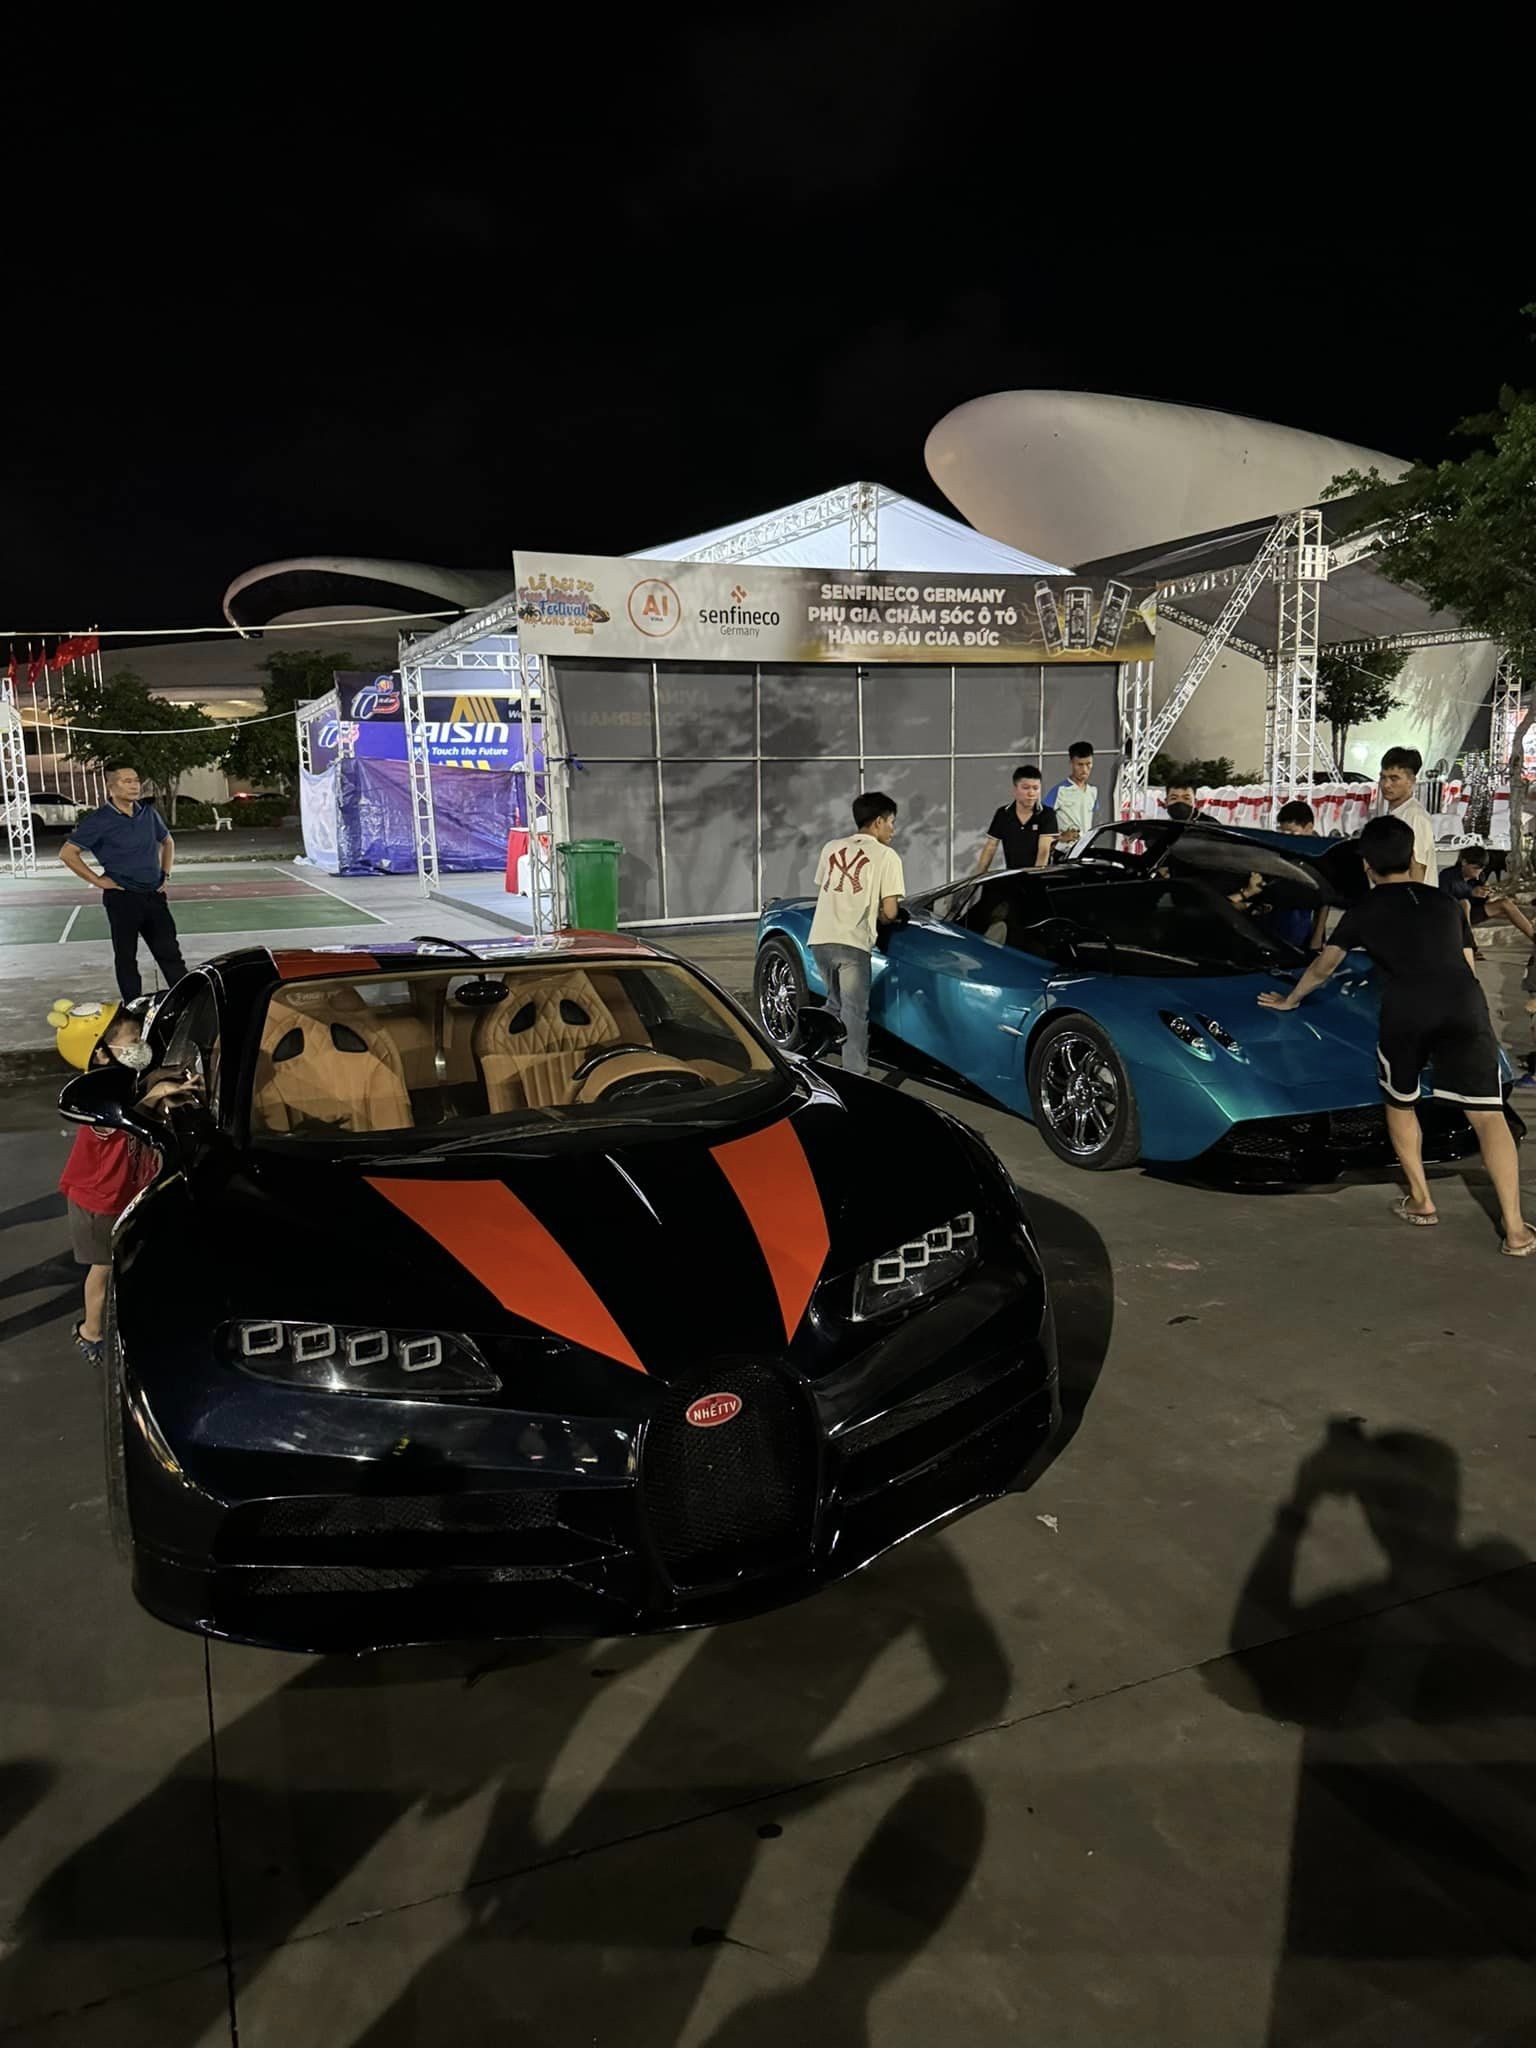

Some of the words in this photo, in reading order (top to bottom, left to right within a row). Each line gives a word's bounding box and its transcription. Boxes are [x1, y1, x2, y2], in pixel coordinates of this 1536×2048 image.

[821, 584, 919, 601] SENFINECO
[923, 587, 1006, 603] GERMANY
[539, 600, 588, 617] Festival
[642, 594, 669, 616] AI
[699, 605, 780, 625] senfineco
[808, 606, 846, 626] PHỤ
[850, 607, 881, 623] GIA
[885, 605, 936, 624] CHĂM
[940, 606, 974, 625] SÓC
[978, 606, 991, 625] Ô
[994, 606, 1017, 625] TÔ
[720, 625, 760, 637] Germany
[828, 625, 879, 645] HÀNG
[882, 625, 920, 646] ĐẦU
[924, 625, 960, 646] CỦA
[963, 627, 1000, 646] ĐỨC
[432, 746, 459, 756] Touch
[461, 746, 477, 756] the
[478, 747, 508, 756] Future
